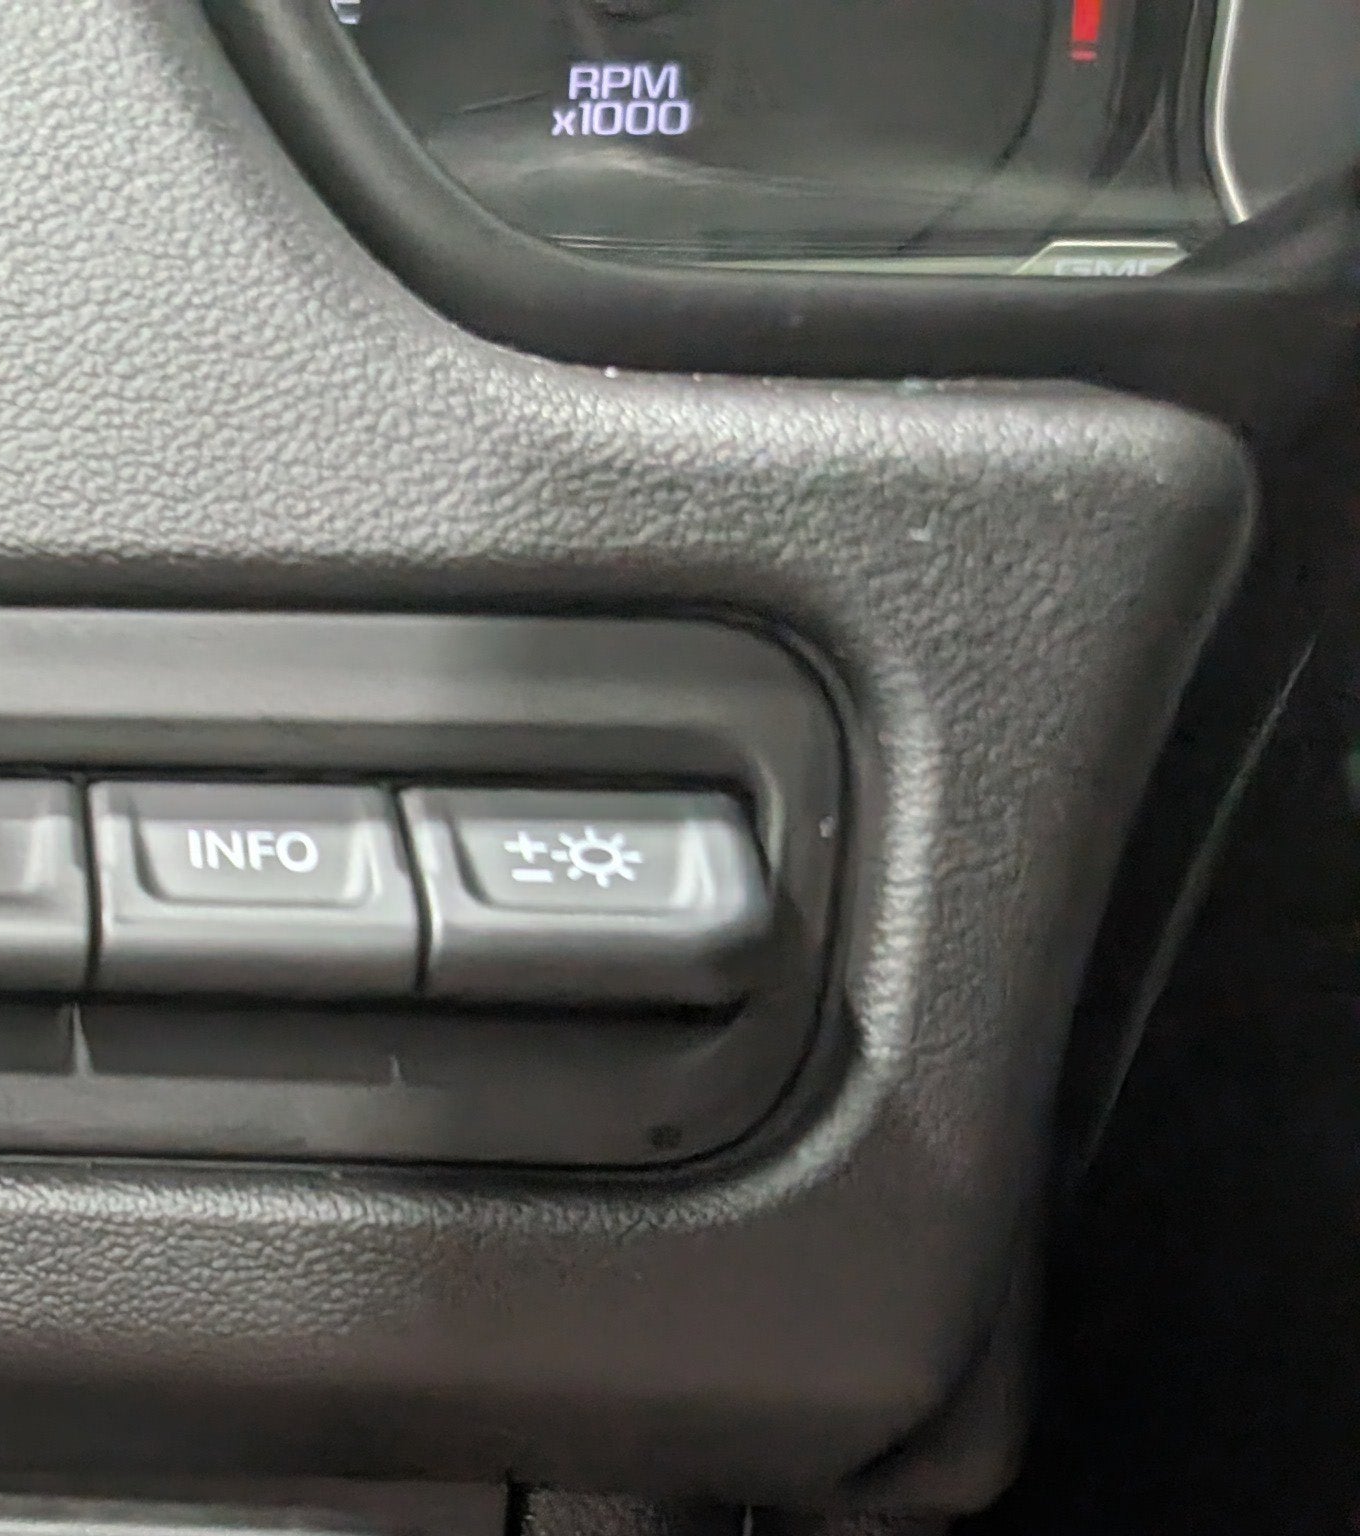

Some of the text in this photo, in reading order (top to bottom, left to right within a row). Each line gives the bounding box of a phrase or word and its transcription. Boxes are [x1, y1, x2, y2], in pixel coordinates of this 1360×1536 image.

[568, 63, 679, 100] RPM
[551, 100, 691, 136] x1000
[186, 828, 319, 873] INFO
